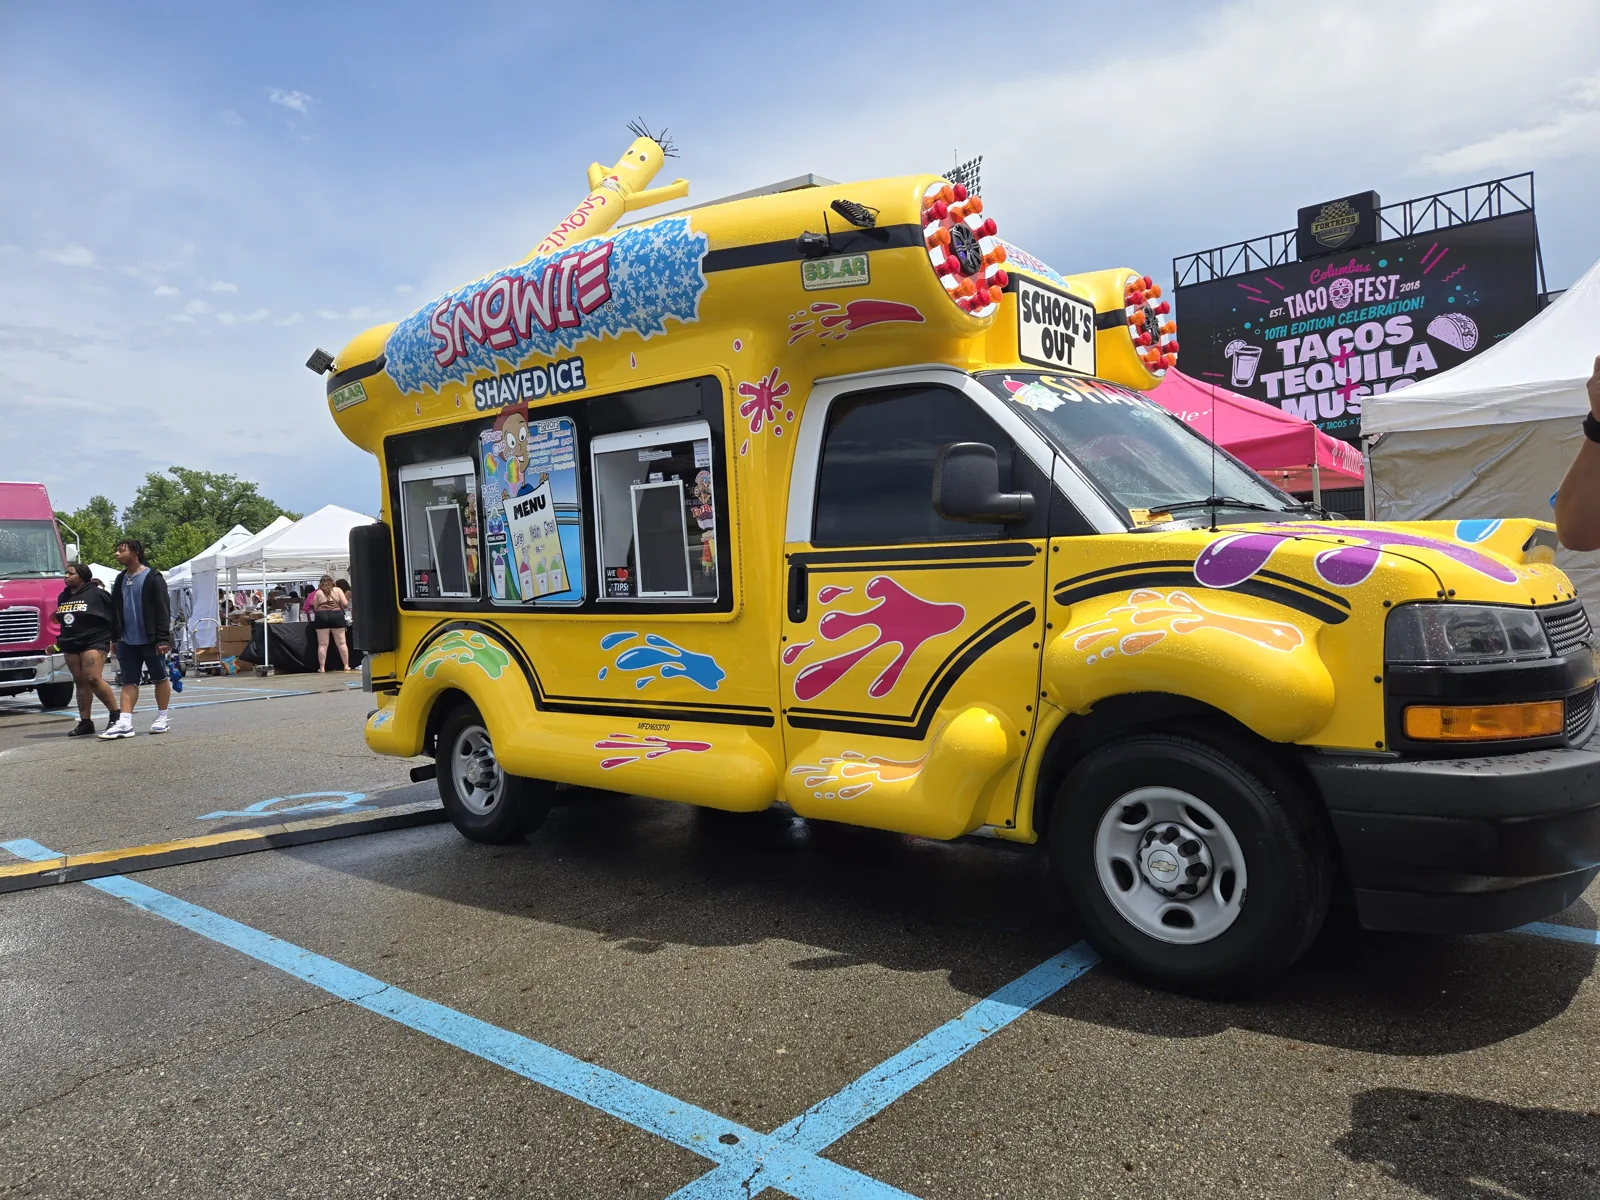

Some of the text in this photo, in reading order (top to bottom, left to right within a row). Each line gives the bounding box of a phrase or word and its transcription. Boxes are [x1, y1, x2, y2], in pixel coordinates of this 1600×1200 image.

[1314, 215, 1356, 231] FORTRESS
[804, 257, 866, 281] SOLAR
[1310, 257, 1371, 285] Columbus
[430, 242, 612, 366] SNOWIE
[1269, 274, 1421, 319] EST. TACO FEST 2018
[1021, 289, 1092, 344] SCHOOL'S
[1264, 296, 1425, 340] 10TH EDITION CELEBRATION!
[1041, 326, 1076, 366] OUT
[1277, 315, 1414, 366] TACOS
[474, 360, 584, 407] SHAVED ICE
[1260, 343, 1438, 399] TEQUILA
[537, 420, 560, 432] Flavors
[1326, 419, 1347, 430] TACOS
[481, 483, 499, 496] Extra
[483, 494, 501, 508] Large
[513, 494, 546, 520] MENU
[607, 569, 616, 577] WE
